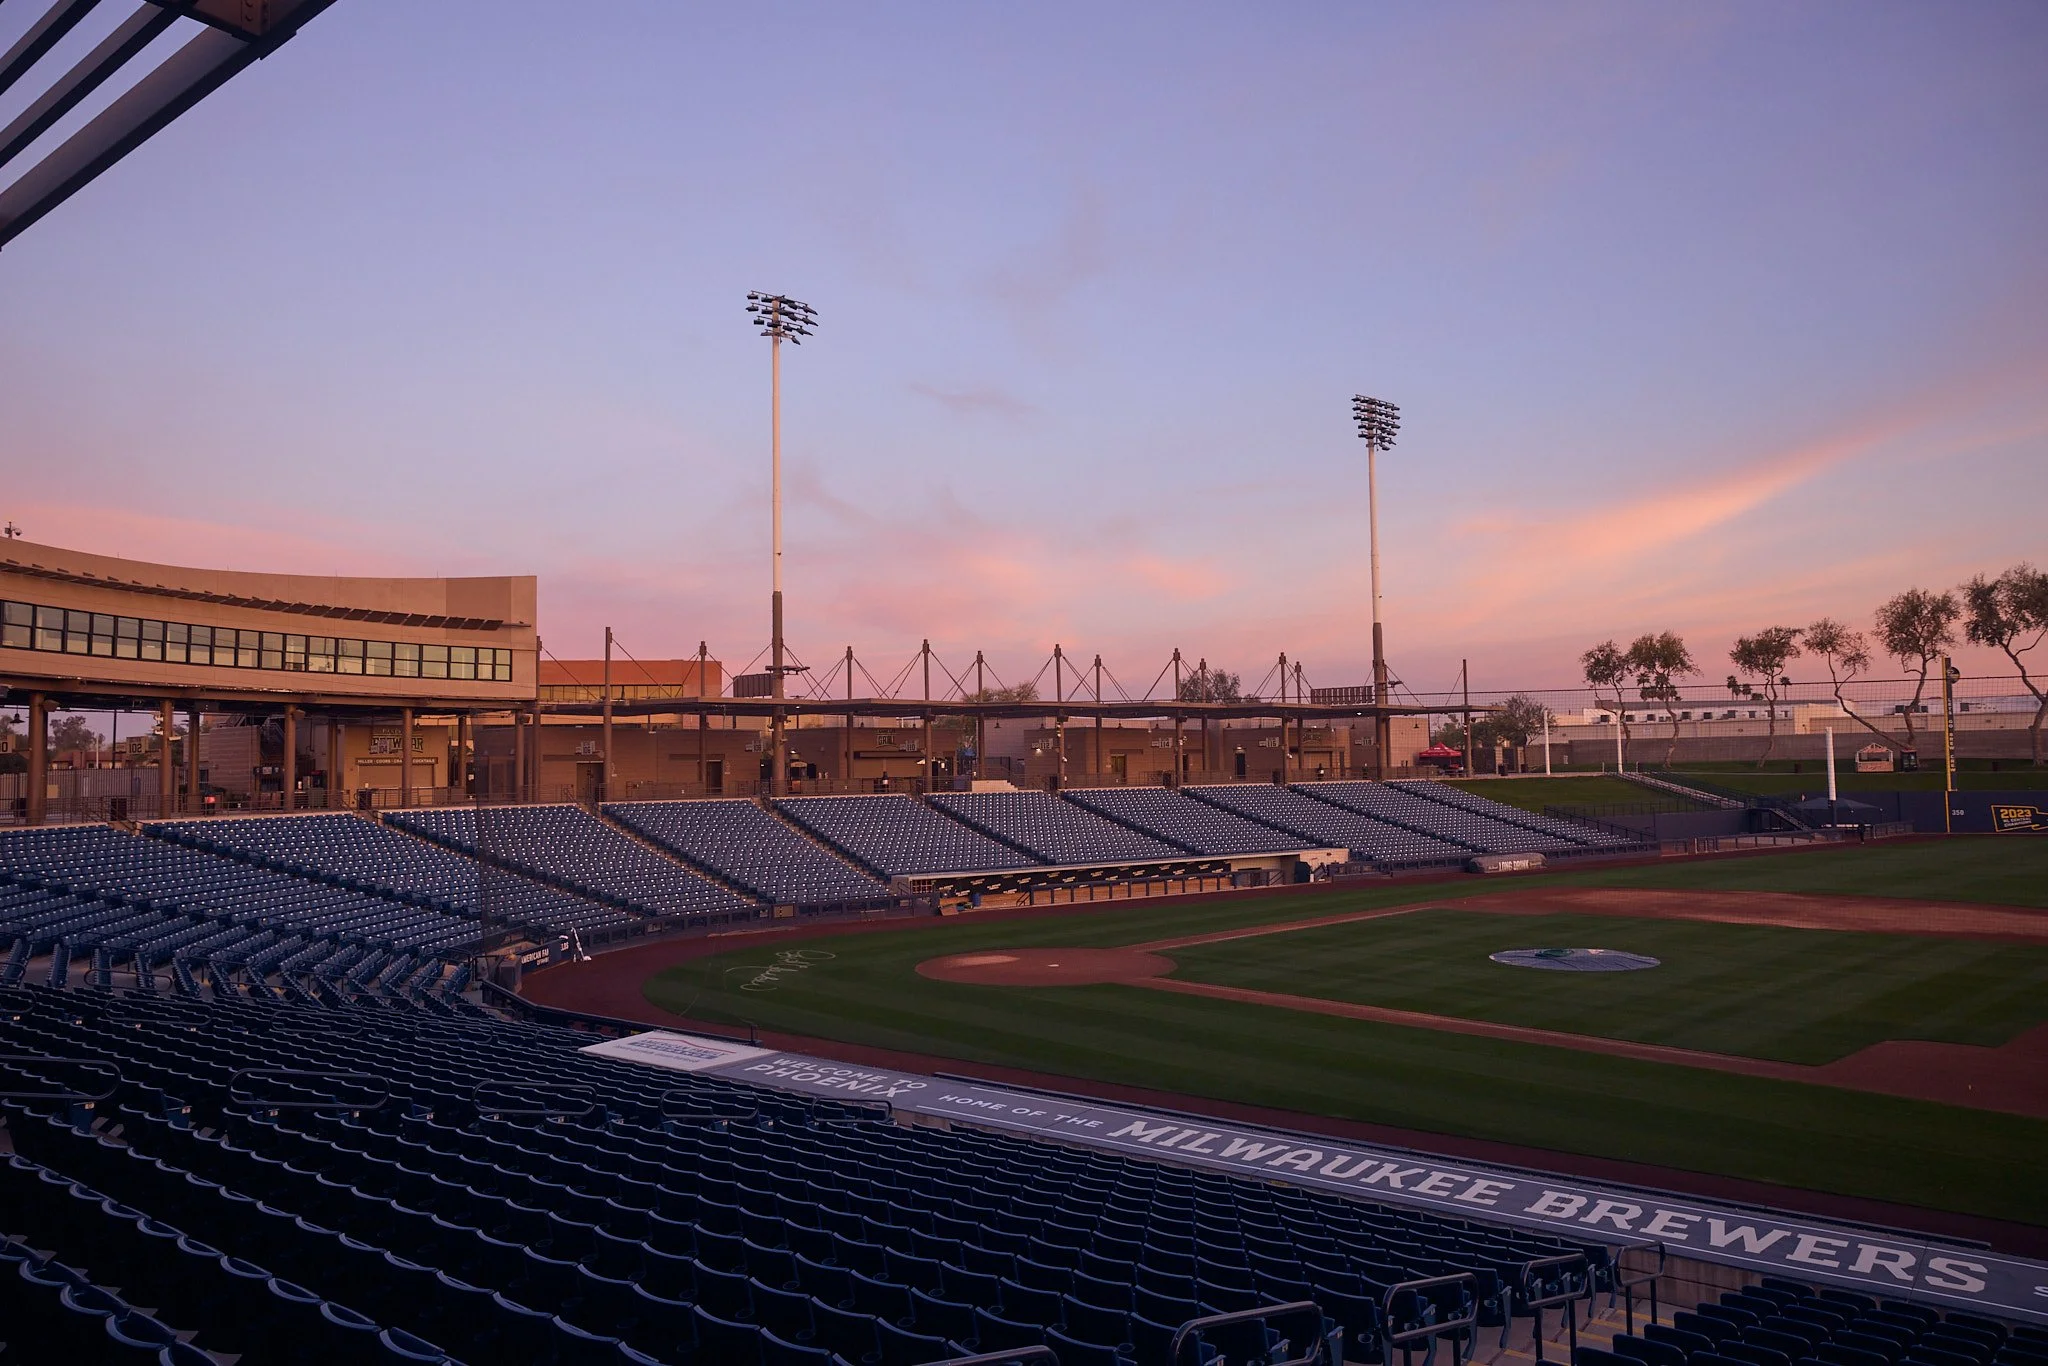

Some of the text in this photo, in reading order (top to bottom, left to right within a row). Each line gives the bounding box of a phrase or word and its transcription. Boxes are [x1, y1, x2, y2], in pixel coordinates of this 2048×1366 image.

[129, 743, 142, 753] 102
[2000, 808, 2032, 819] 2023
[743, 1063, 911, 1098] PHOENIX
[771, 1058, 928, 1089] WELCOME TO
[938, 1094, 1104, 1128] HOME OF THE
[1106, 1120, 1989, 1294] MILWAUKEE BREWERS
